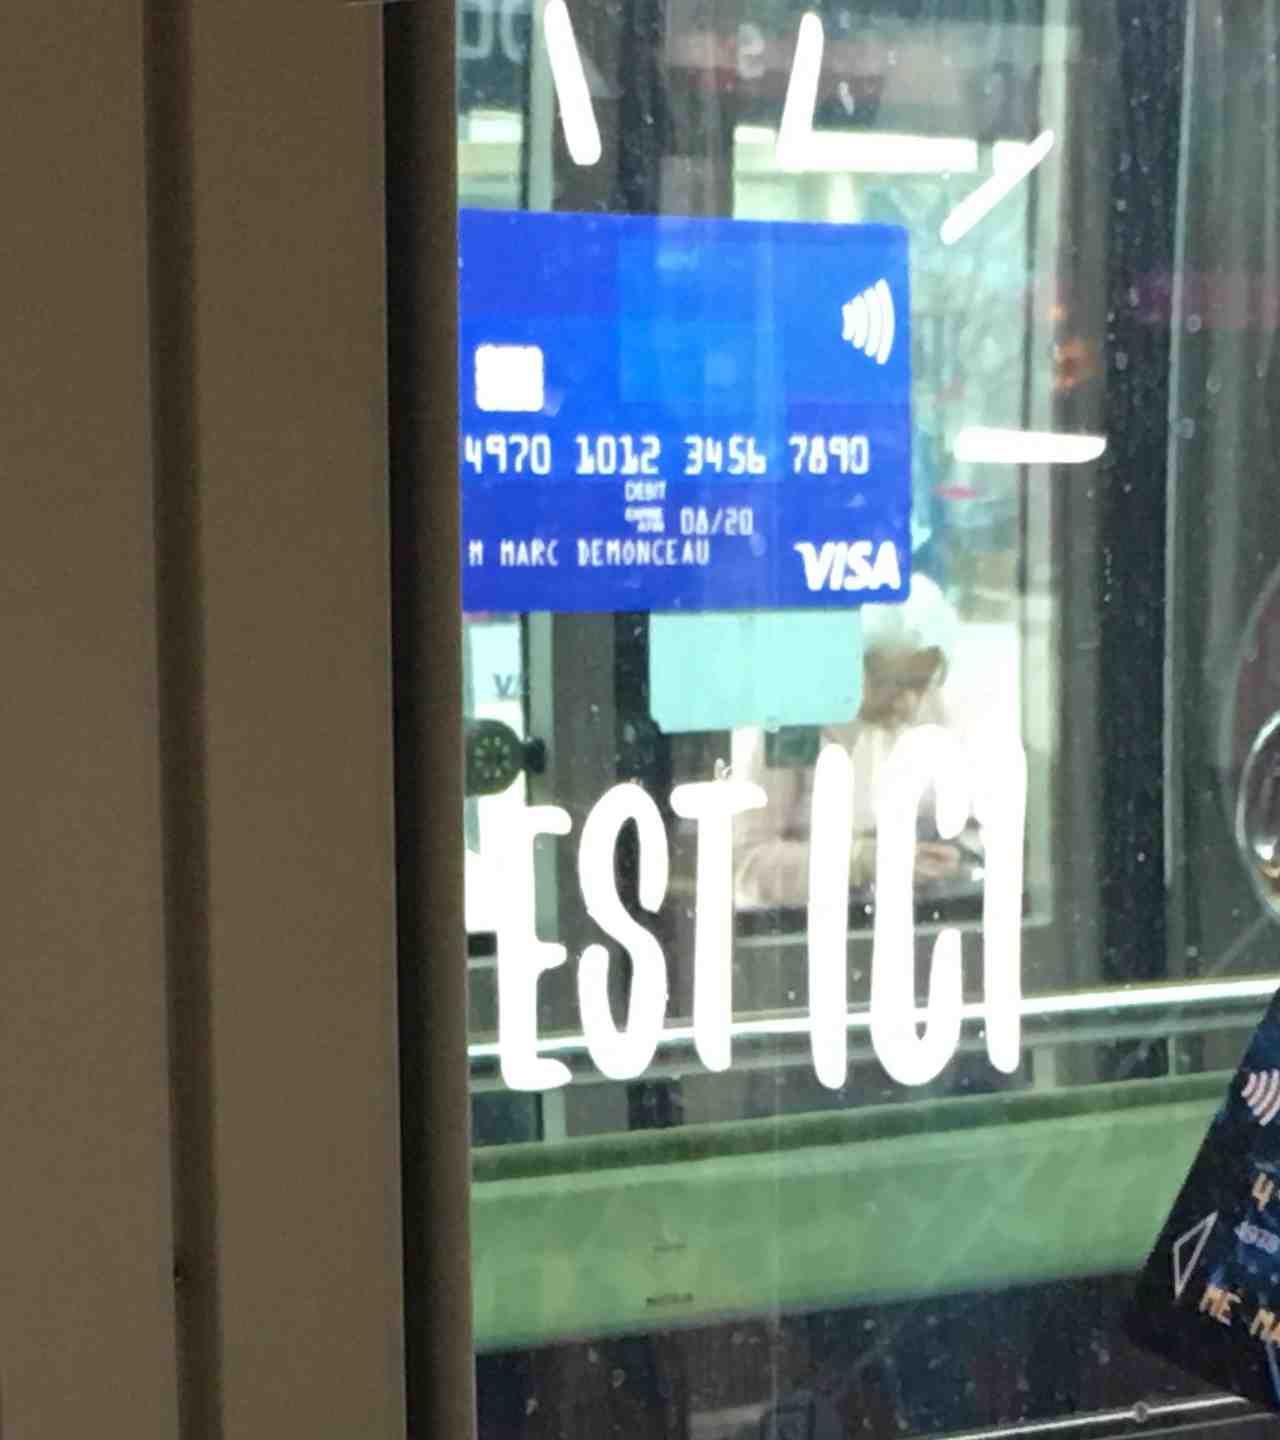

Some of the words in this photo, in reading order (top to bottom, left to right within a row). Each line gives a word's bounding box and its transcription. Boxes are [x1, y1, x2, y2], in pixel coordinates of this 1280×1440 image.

[464, 434, 552, 475] 4970
[576, 434, 661, 475] 1012
[684, 434, 766, 475] 3456
[788, 434, 869, 475] 7890
[468, 540, 483, 565] M
[500, 539, 560, 566] MARC
[577, 538, 709, 567] DEMONCEAU
[794, 541, 901, 591] VISA
[808, 728, 1026, 1090] ICI
